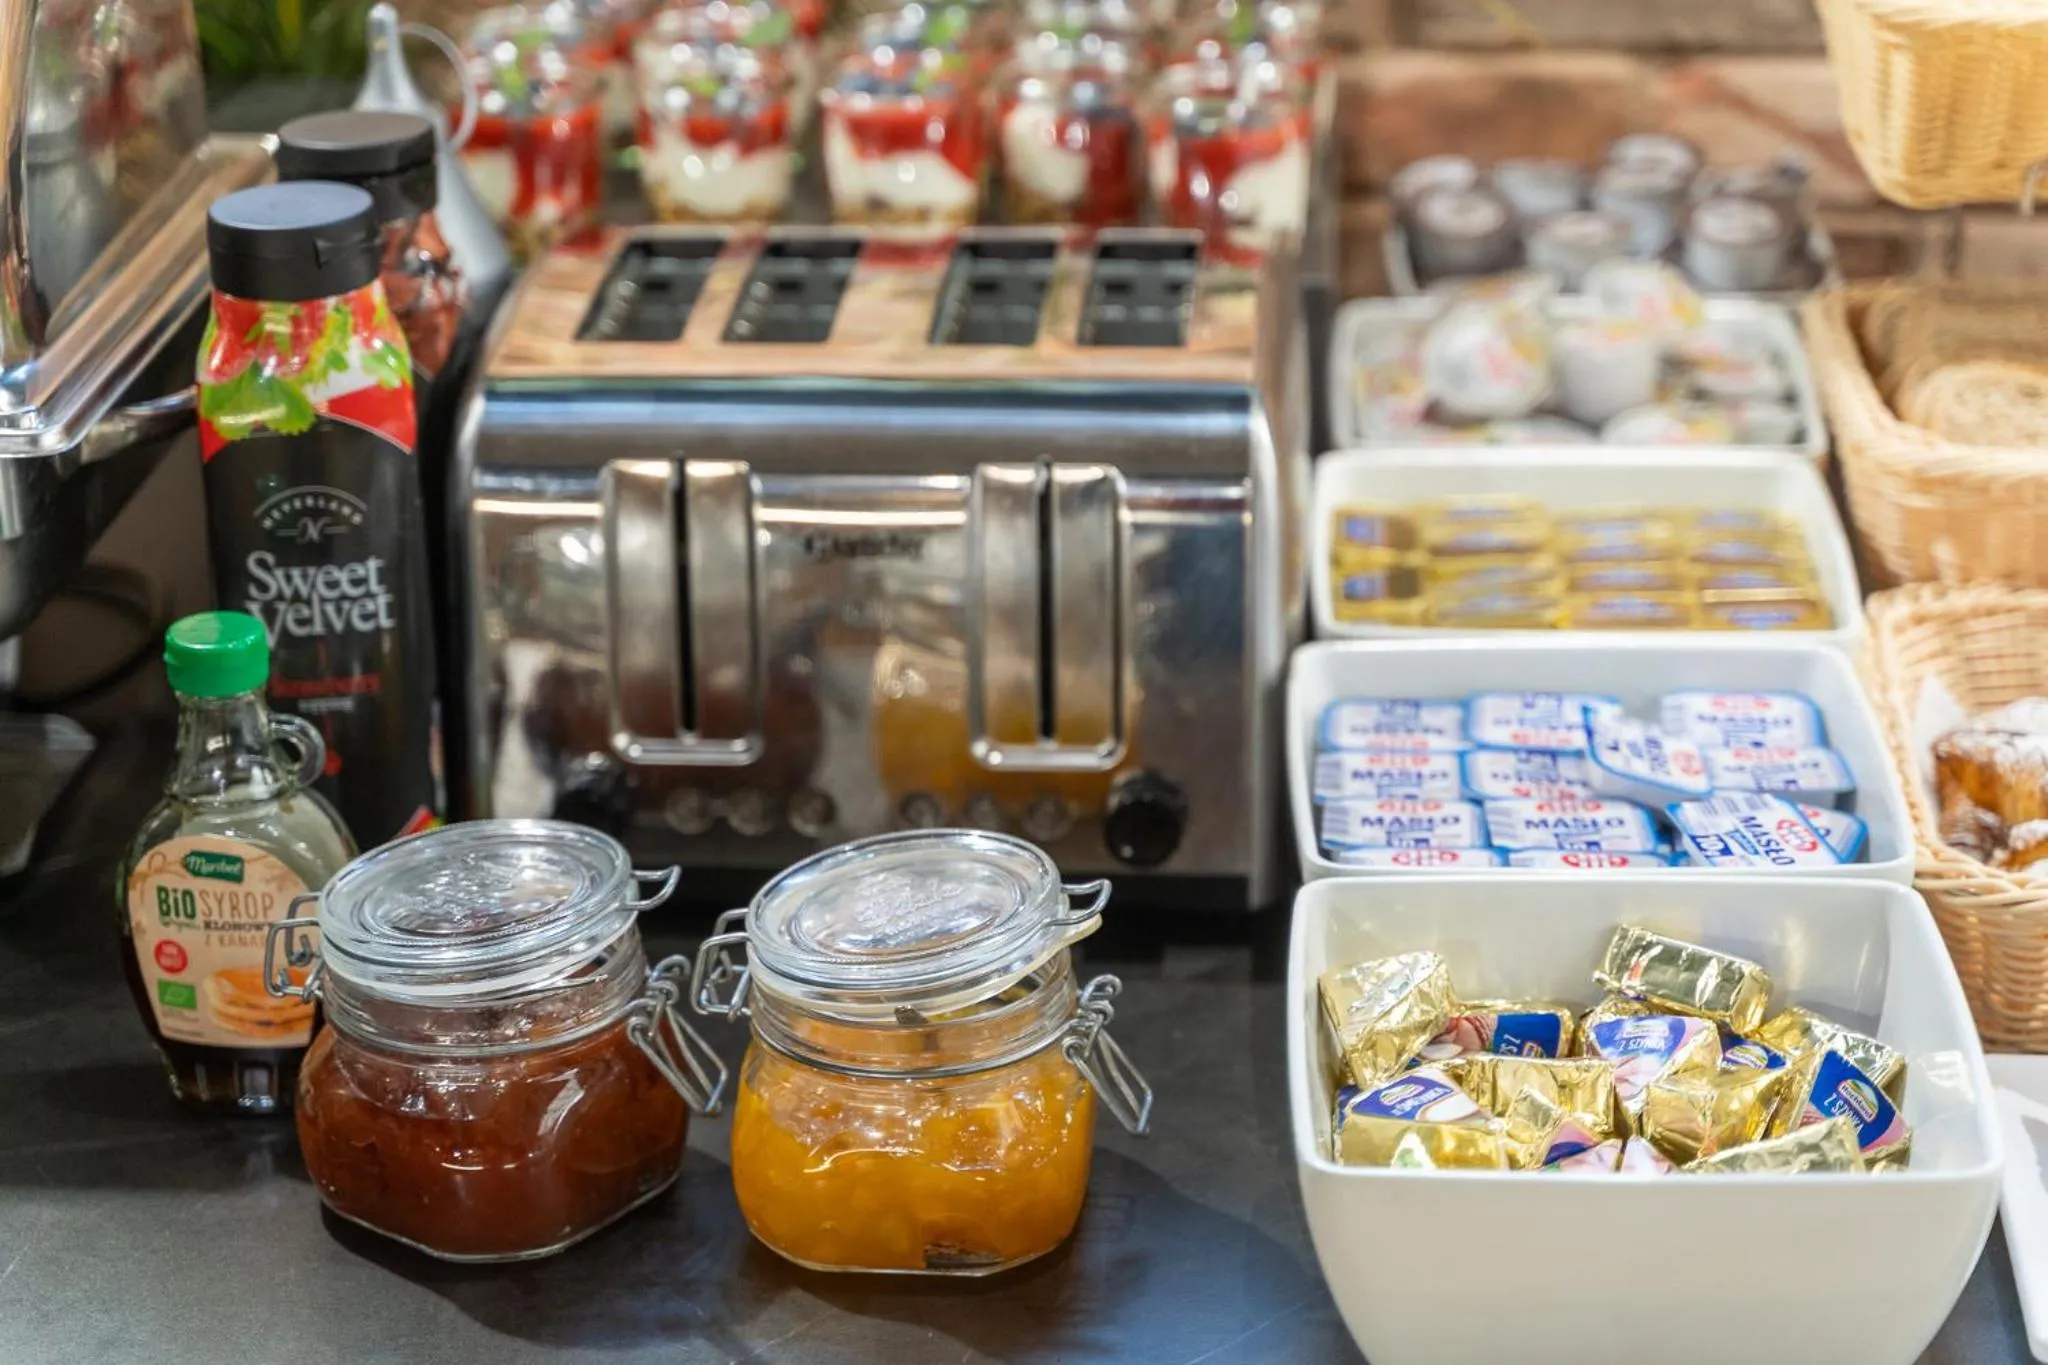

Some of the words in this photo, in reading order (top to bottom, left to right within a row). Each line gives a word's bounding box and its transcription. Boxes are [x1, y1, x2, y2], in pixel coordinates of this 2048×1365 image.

[246, 550, 386, 600] Sweet
[245, 590, 396, 649] Velvet
[1738, 815, 1797, 866] MASŁO
[200, 889, 274, 920] SYROP
[203, 920, 268, 932] KLONOW
[1841, 1084, 1874, 1120] Hochland
